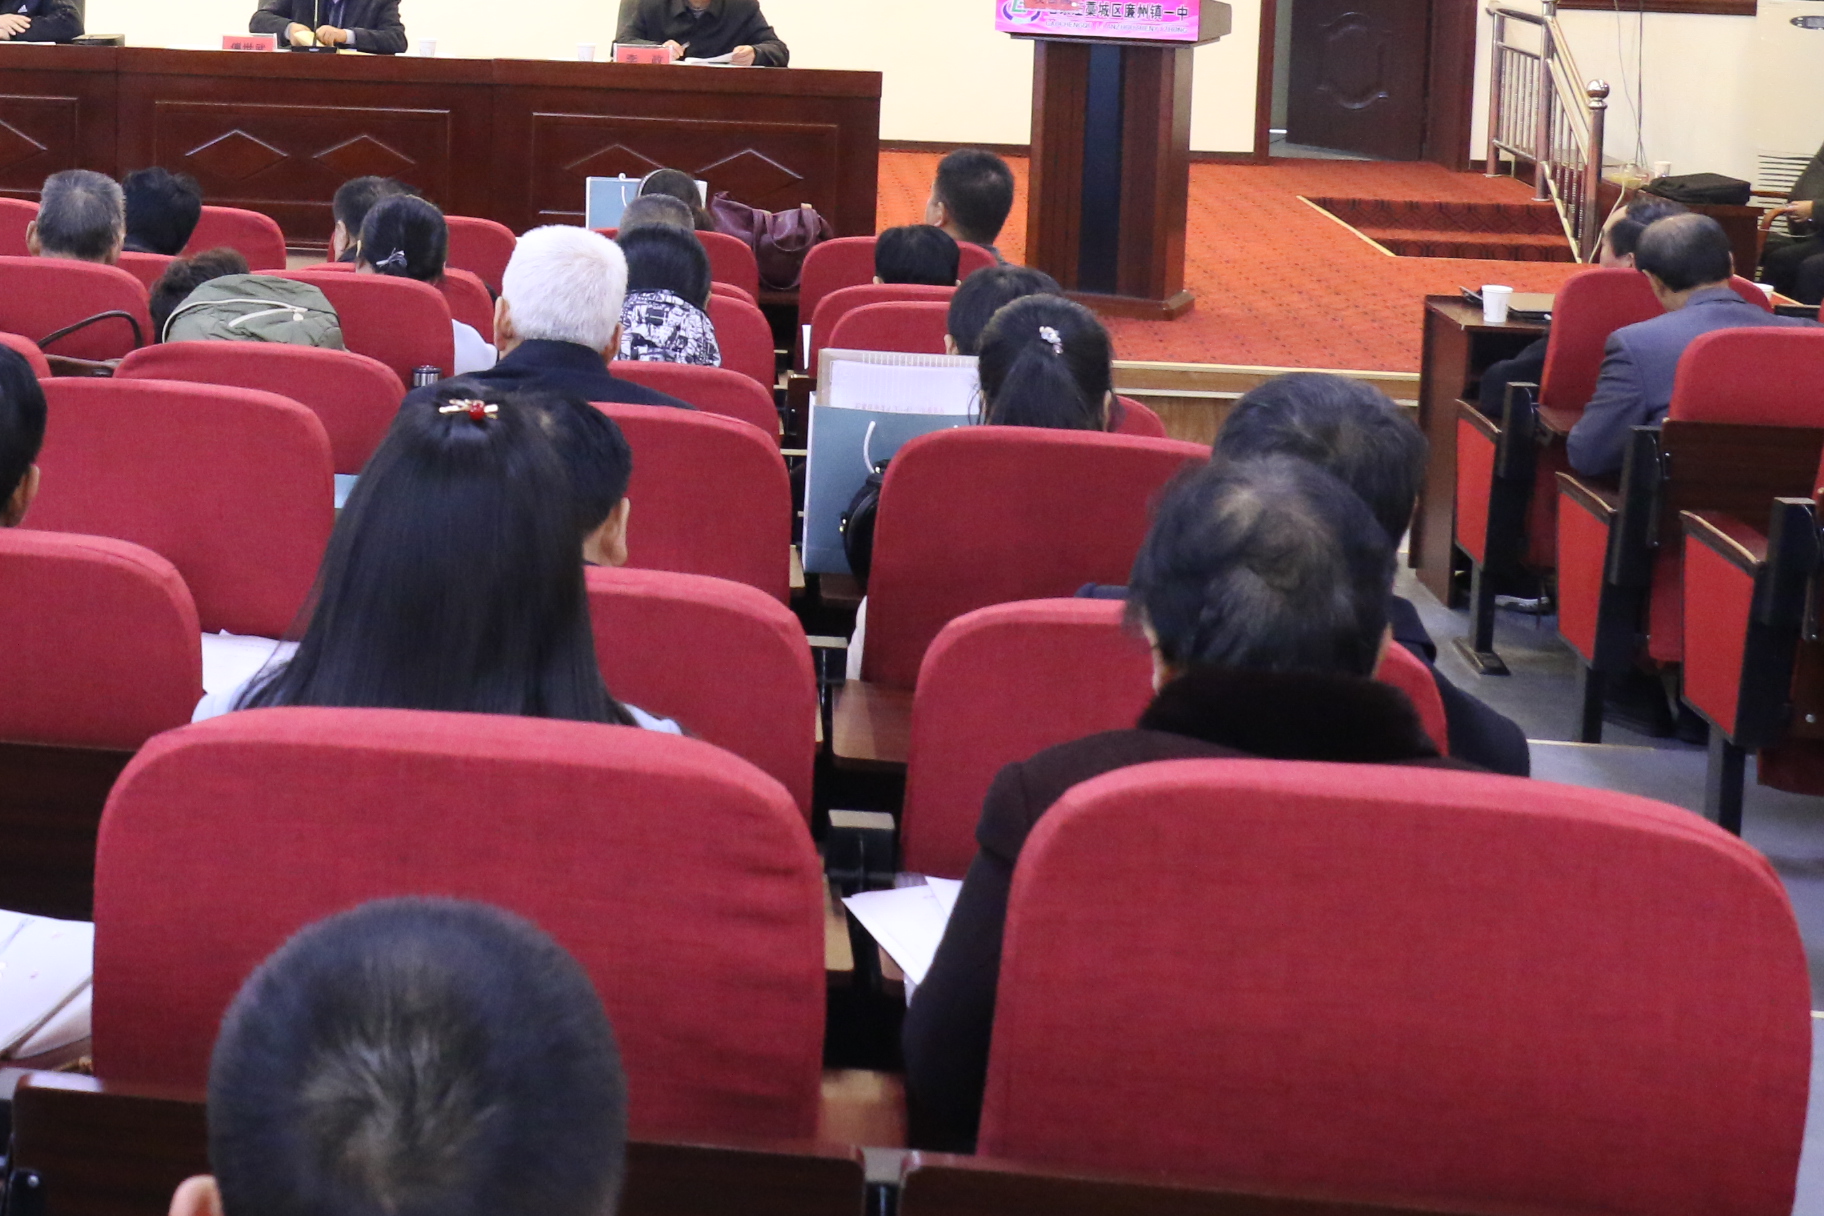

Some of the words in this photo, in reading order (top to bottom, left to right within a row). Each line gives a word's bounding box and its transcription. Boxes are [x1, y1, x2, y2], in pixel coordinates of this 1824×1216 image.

[1048, 1, 1190, 21] 藁城区廉州镇一中
